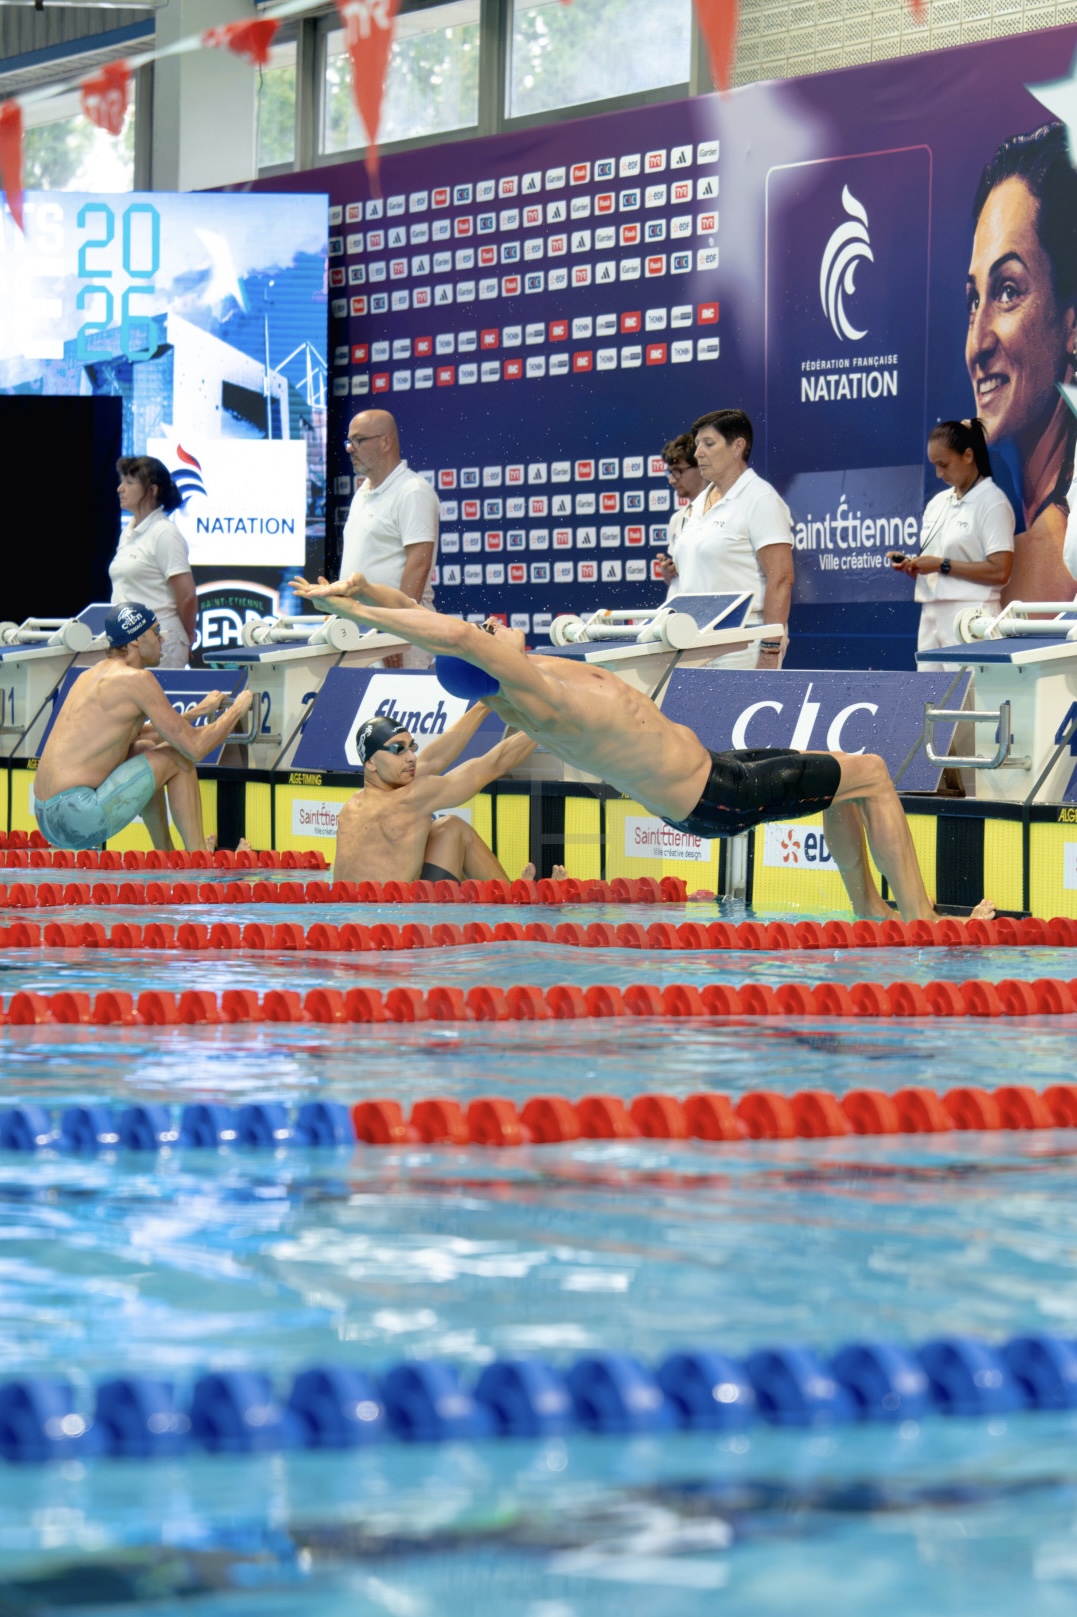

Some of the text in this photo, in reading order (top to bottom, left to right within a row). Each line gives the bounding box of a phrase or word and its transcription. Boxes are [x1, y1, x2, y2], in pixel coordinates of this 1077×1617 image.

[77, 202, 160, 279] 20
[76, 285, 158, 361] 26
[802, 354, 898, 371] FÉDÉRATION FRANÇAISE
[802, 370, 898, 402] NATATION
[196, 518, 294, 534] NATATION
[819, 554, 839, 570] Ville
[841, 552, 882, 570] créative
[8, 686, 14, 726] 1
[261, 690, 271, 734] 2
